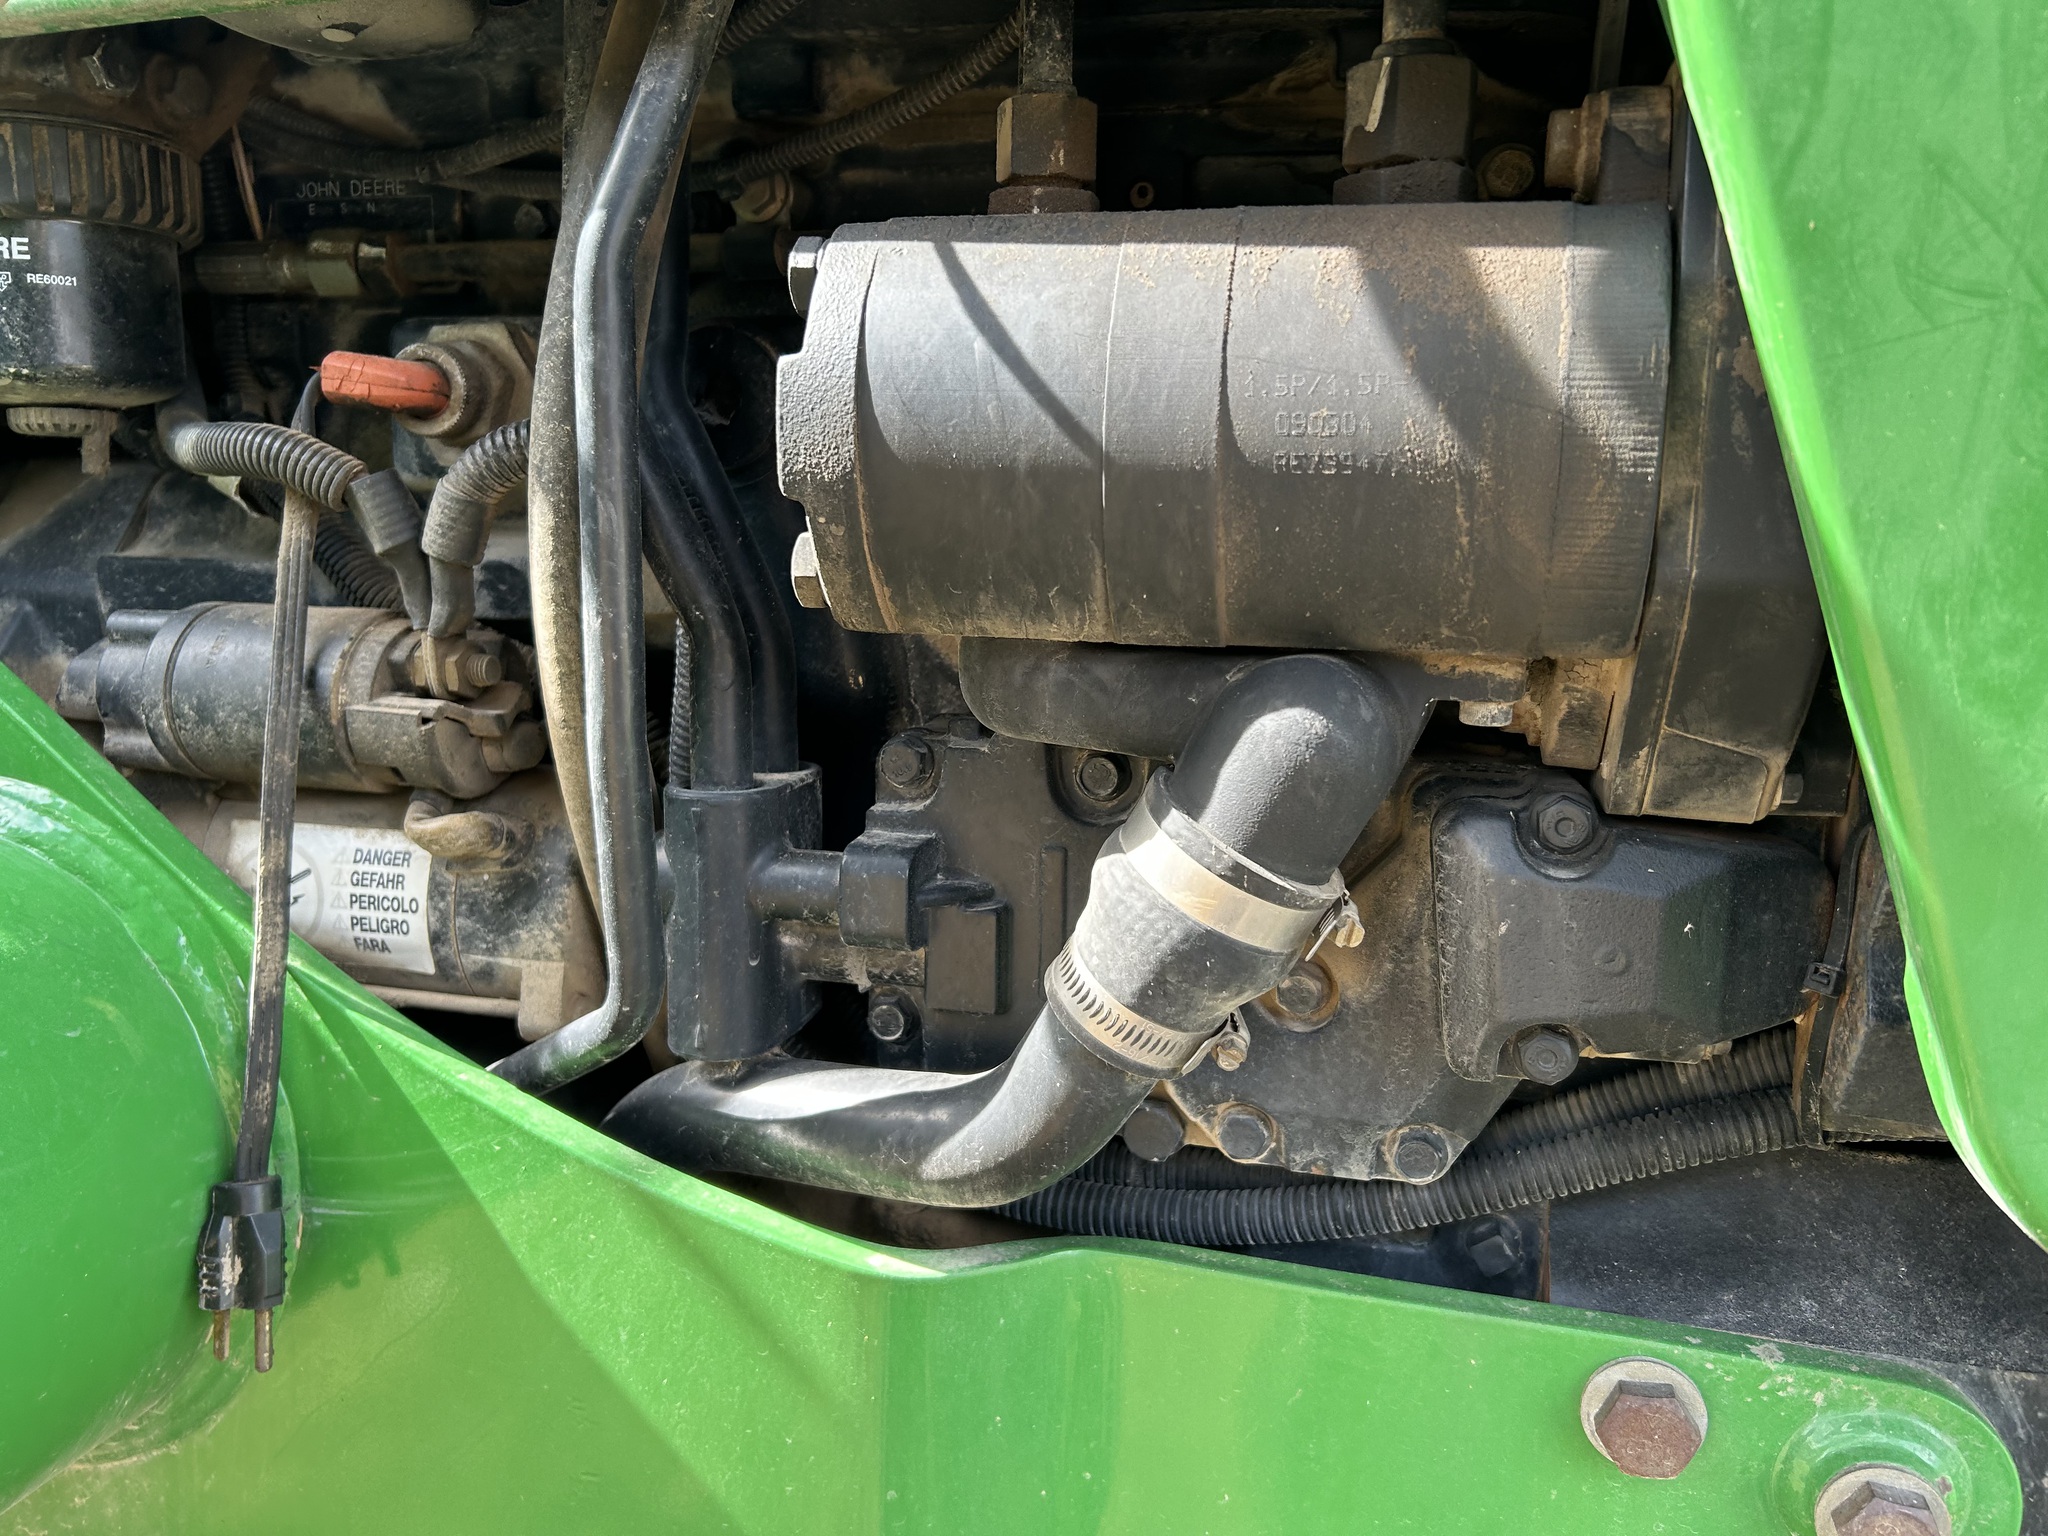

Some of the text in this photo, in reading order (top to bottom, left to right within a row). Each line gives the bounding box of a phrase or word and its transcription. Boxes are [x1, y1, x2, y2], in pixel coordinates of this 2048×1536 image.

[297, 180, 406, 198] JOHN DEERE
[26, 272, 77, 287] RE60021
[352, 847, 412, 868] DANGER
[350, 870, 406, 890] GEFAHR
[349, 893, 419, 914] PERICOLO
[350, 915, 410, 935] PELIGRO
[353, 936, 391, 954] FARA
